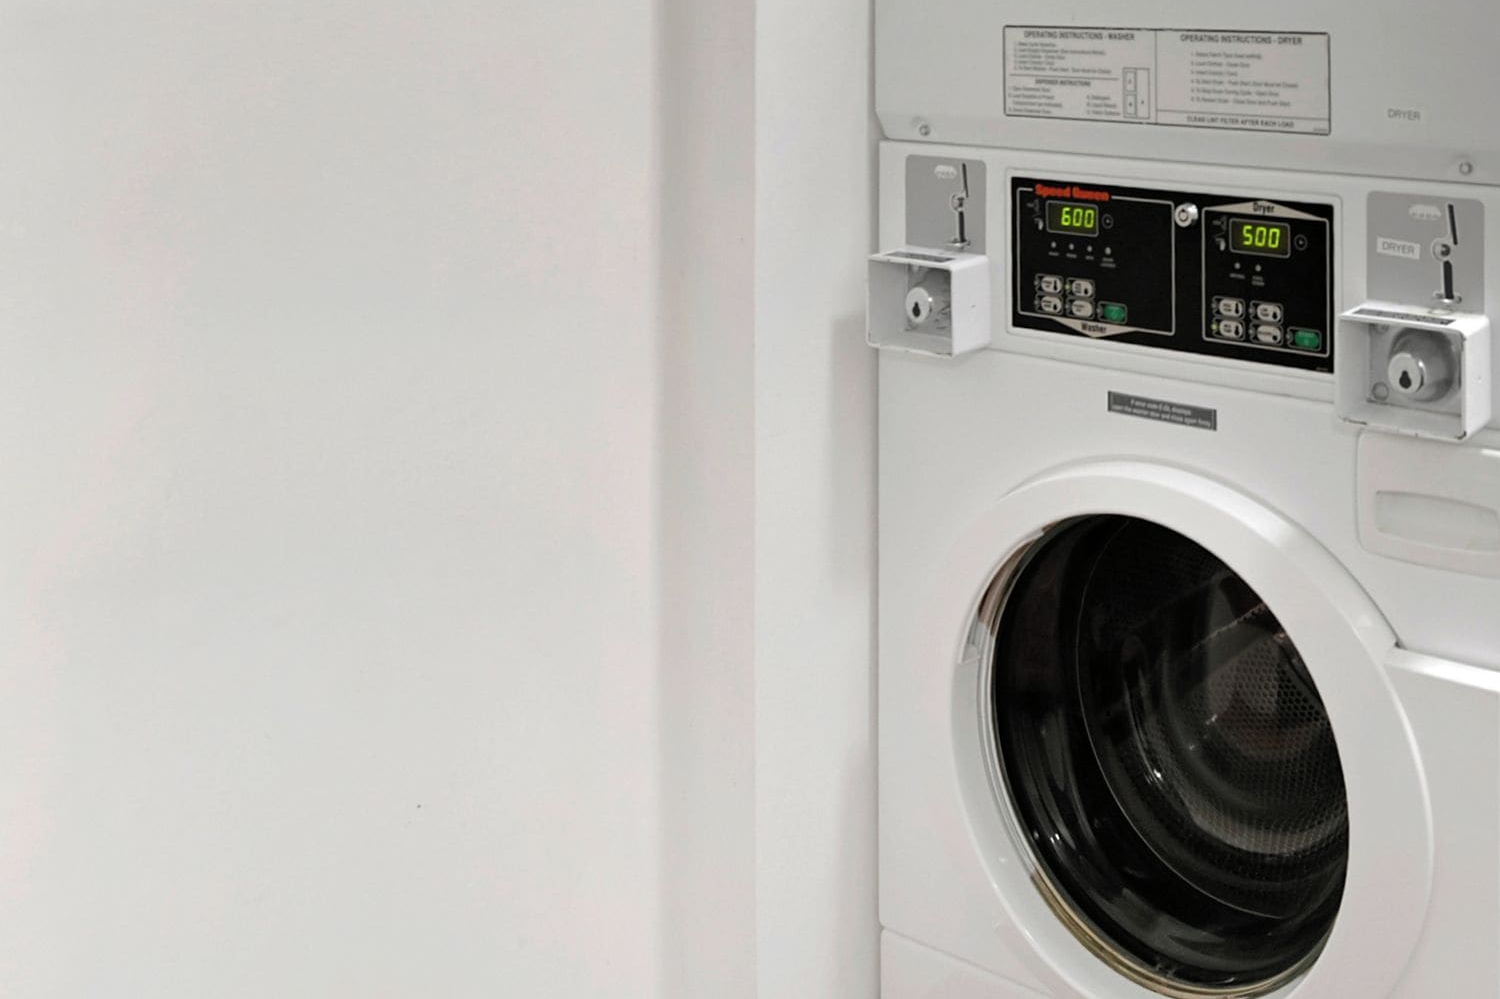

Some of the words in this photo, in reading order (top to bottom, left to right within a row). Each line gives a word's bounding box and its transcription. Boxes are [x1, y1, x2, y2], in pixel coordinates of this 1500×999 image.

[1024, 31, 1057, 39] OPERATING
[1059, 32, 1103, 40] INSTRUCTIONS
[1180, 34, 1219, 42] OPERATING
[1221, 36, 1272, 44] INSTRUCTIONS
[1278, 36, 1302, 45] DRYER
[1388, 109, 1420, 121] DRYER
[1035, 184, 1070, 198] Speed
[1072, 187, 1110, 201] Queen
[1253, 203, 1275, 215] Dryer
[1061, 207, 1095, 228] 600
[1243, 225, 1281, 248] 500
[1382, 242, 1415, 254] DRYER
[1081, 322, 1107, 333] Washer
